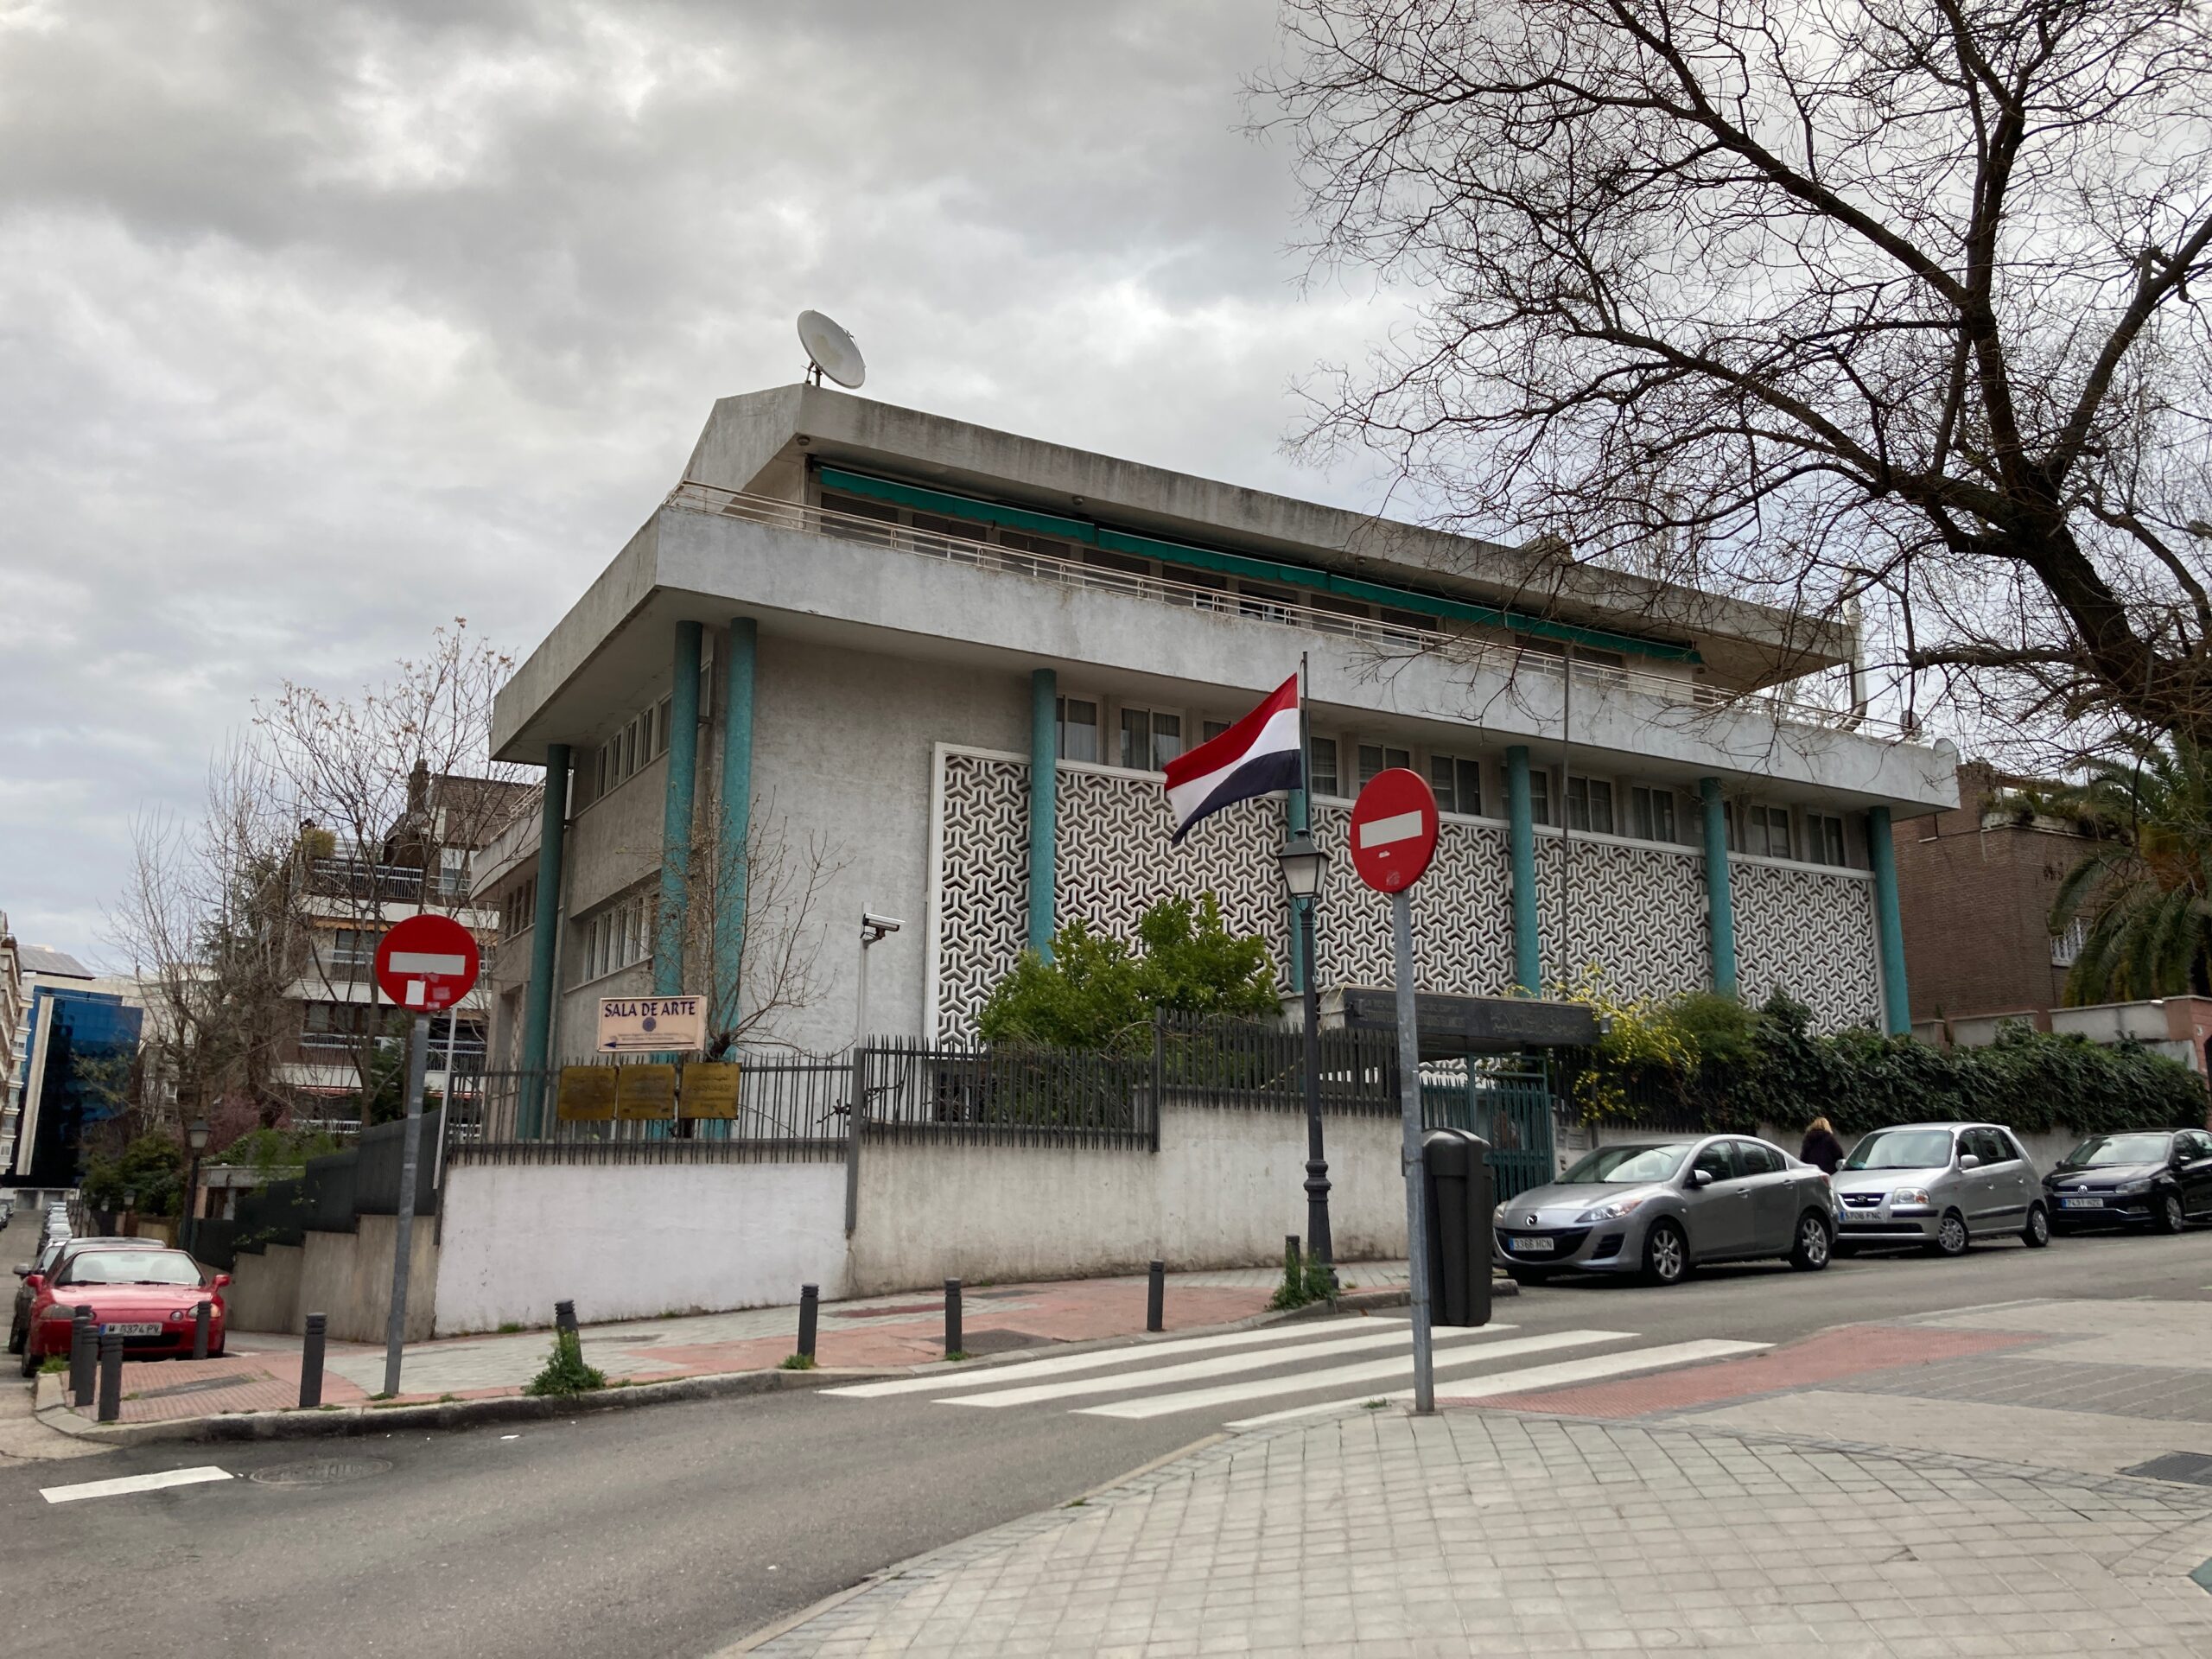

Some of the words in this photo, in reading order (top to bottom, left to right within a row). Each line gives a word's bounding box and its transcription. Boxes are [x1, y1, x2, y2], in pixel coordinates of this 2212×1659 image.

[604, 1002, 638, 1018] SALA
[641, 1001, 658, 1016] DE
[661, 1001, 696, 1015] ARTE
